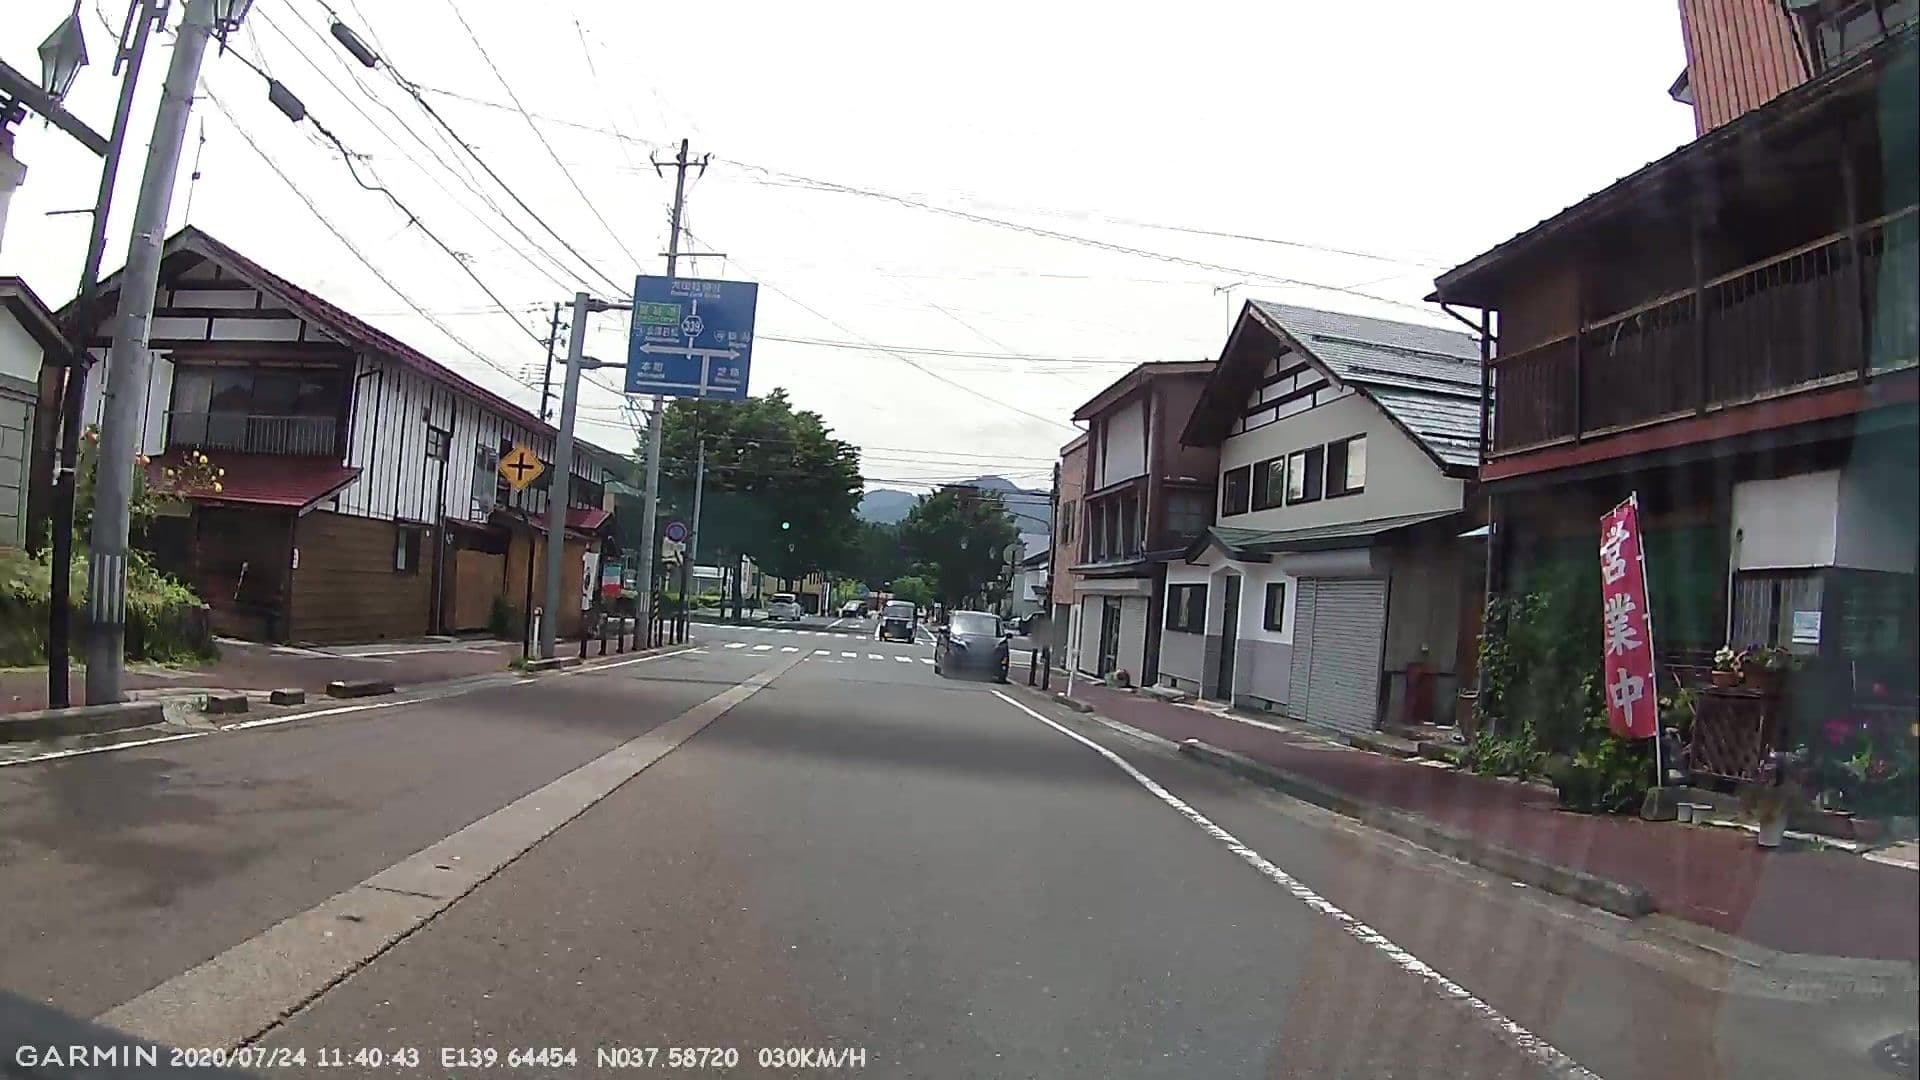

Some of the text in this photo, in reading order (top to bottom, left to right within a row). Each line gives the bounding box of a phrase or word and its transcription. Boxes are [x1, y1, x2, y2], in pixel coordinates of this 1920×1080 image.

[685, 320, 700, 331] 339
[1600, 520, 1643, 728] 営業中
